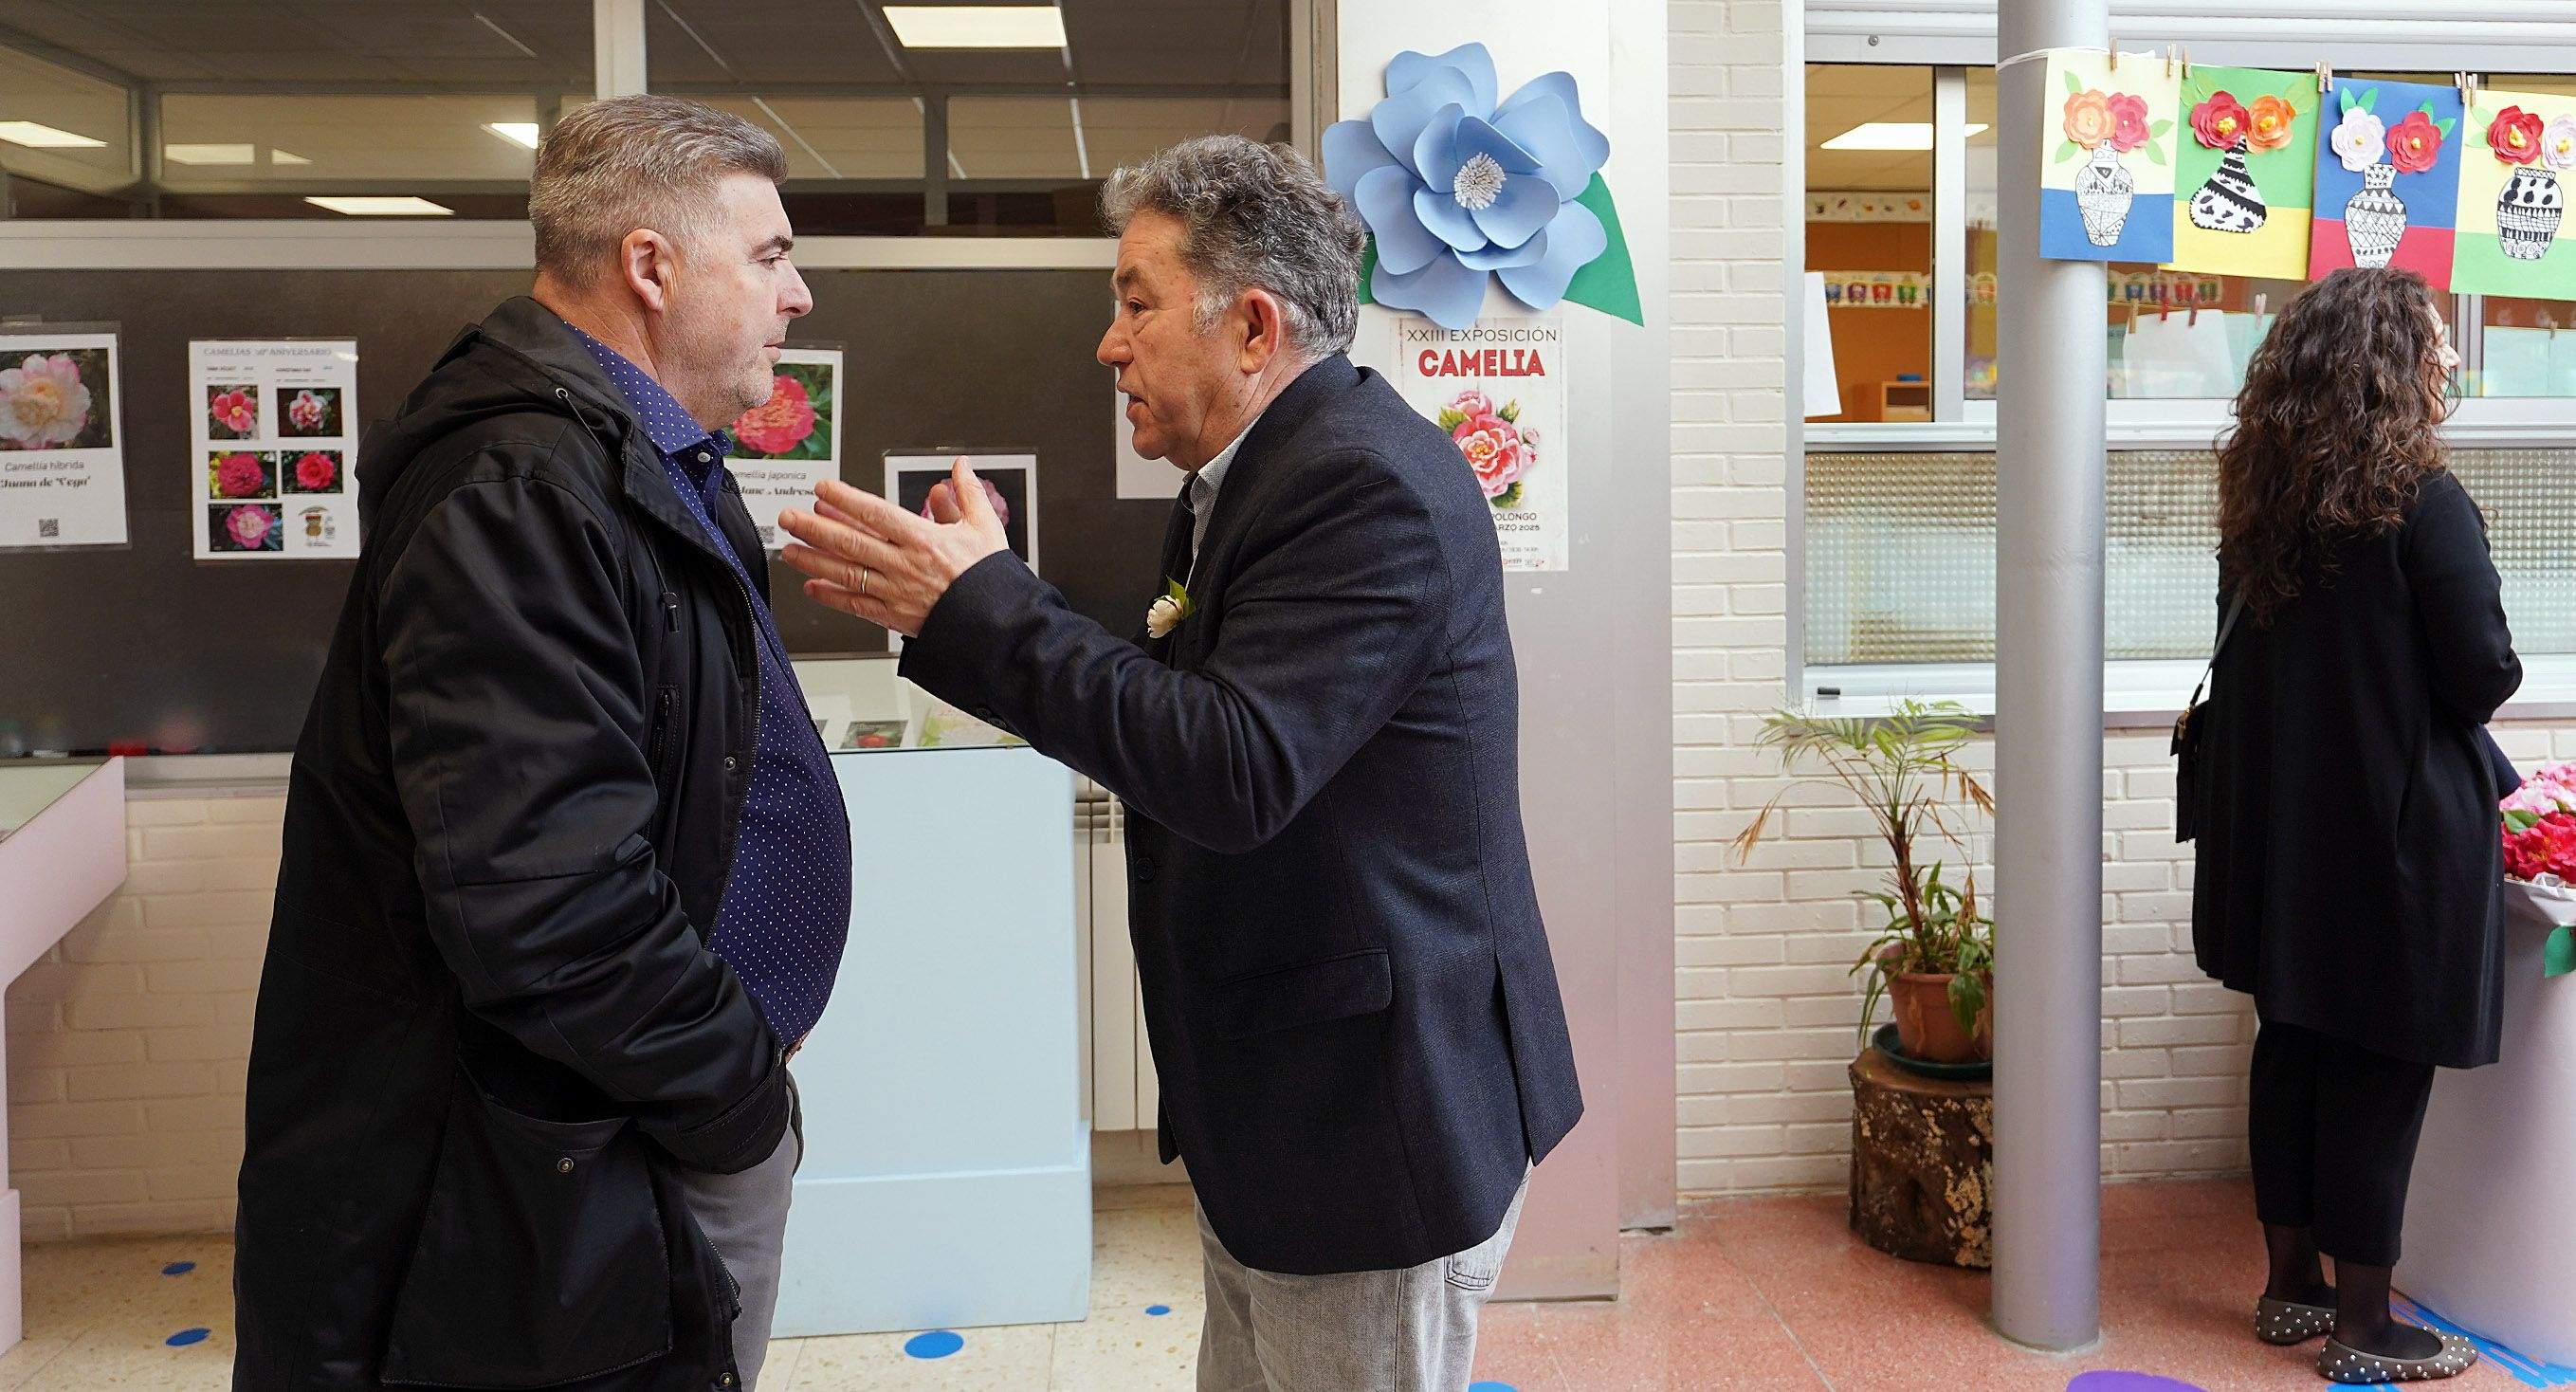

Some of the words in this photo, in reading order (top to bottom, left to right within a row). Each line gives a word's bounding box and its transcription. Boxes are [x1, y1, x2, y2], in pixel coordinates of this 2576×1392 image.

[1407, 329, 1445, 342] XXIII
[1450, 325, 1557, 342] EXPOSICIÓN
[203, 347, 251, 356] CAMELIAS
[269, 347, 332, 357] ANIVERSARIO
[1418, 349, 1545, 377] CAMELIA
[5, 460, 47, 471] Camellia
[733, 470, 765, 480] amellia
[768, 470, 807, 481] japonica
